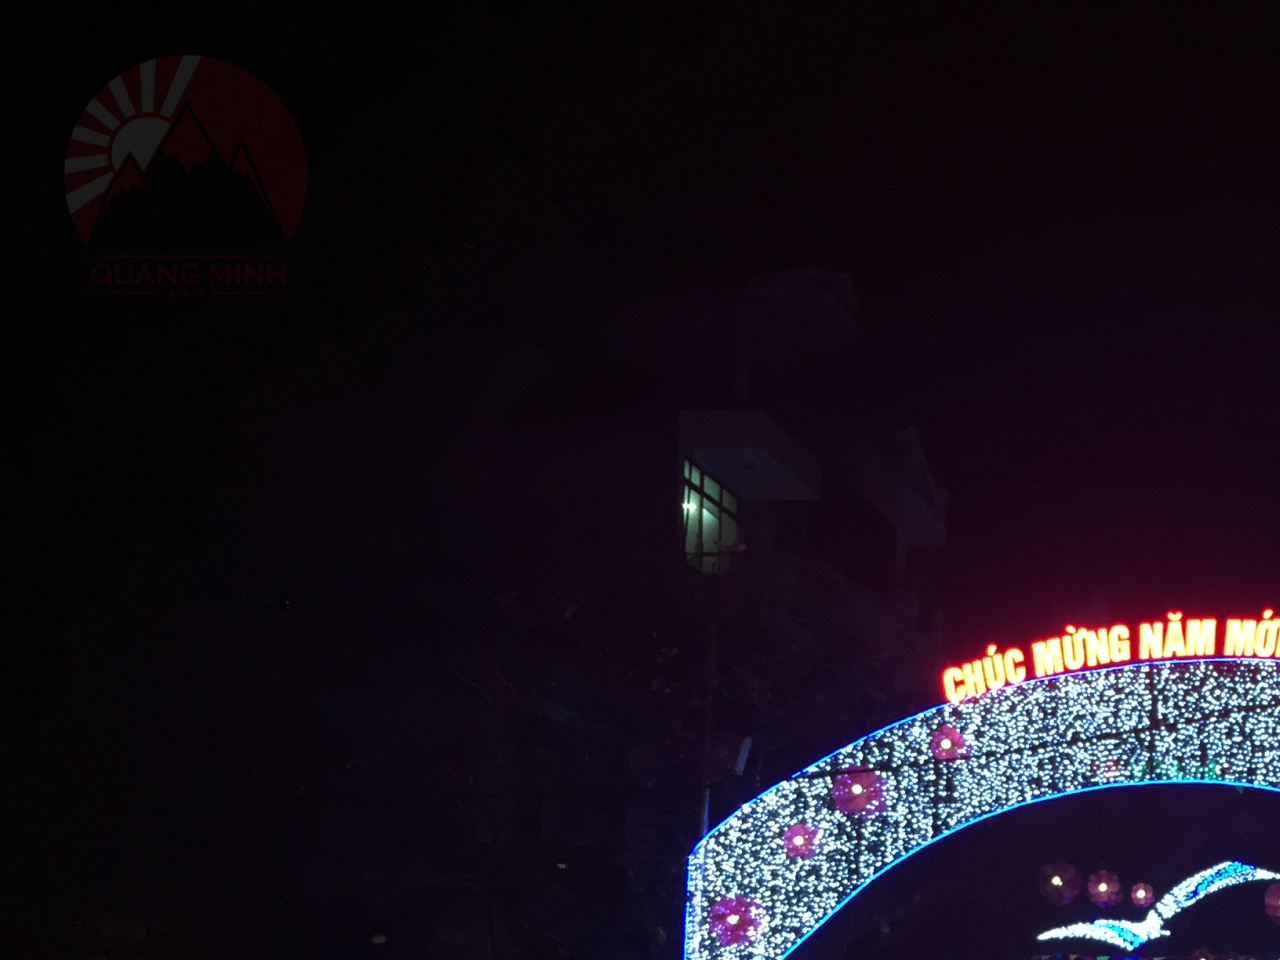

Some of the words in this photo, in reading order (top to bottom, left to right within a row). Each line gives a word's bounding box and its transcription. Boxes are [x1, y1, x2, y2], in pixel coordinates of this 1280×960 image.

[942, 645, 1027, 703] CHÚC
[1031, 624, 1131, 677] MỪNG
[1138, 611, 1217, 659] NĂM
